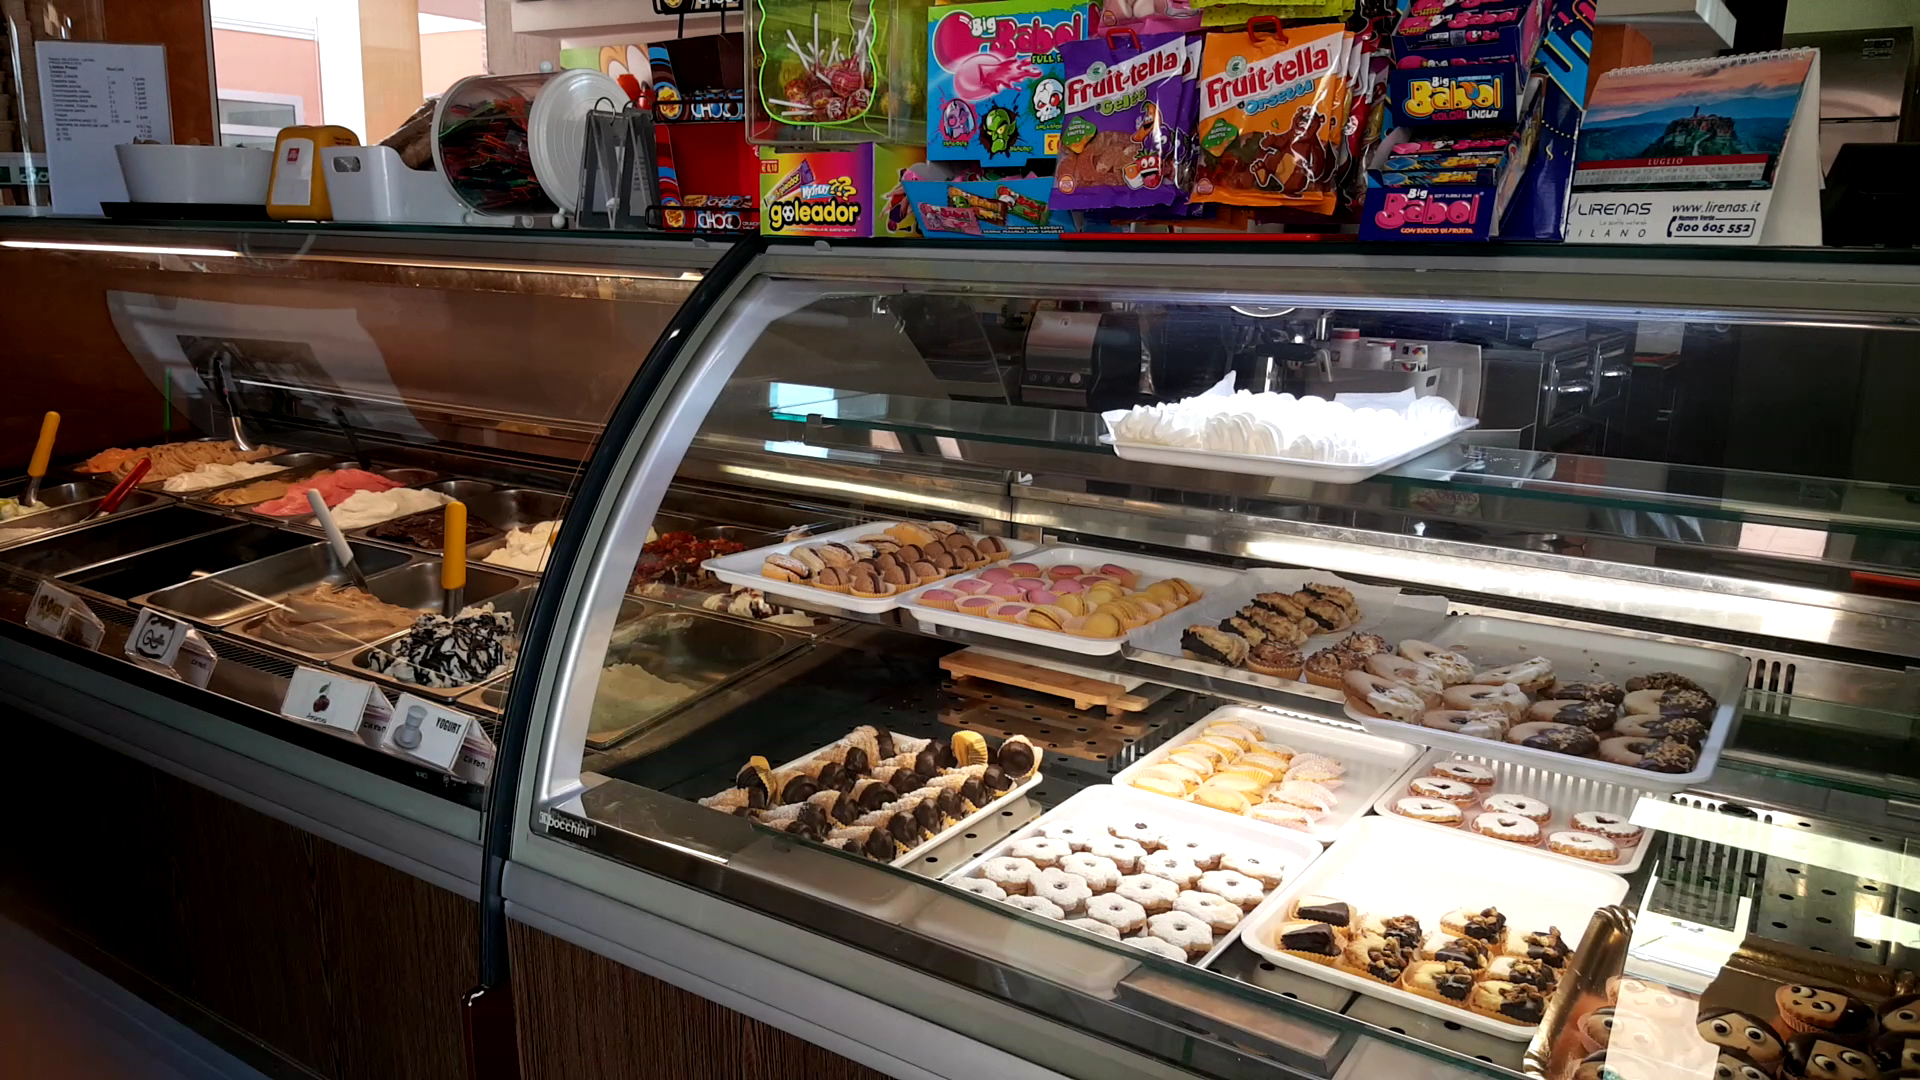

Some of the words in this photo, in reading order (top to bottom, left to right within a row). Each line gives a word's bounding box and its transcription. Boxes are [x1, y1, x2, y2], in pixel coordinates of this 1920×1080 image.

[972, 17, 997, 37] Big
[1032, 54, 1054, 64] FULL
[1067, 50, 1178, 106] Fruit-tella
[1206, 46, 1329, 109] Fruit-tella
[1432, 77, 1449, 87] Big
[1404, 77, 1501, 118] Babol
[1648, 158, 1684, 166] LUGLIO
[1408, 188, 1428, 199] Big
[770, 200, 859, 228] goleador
[1375, 193, 1480, 229] Babol
[1578, 203, 1652, 216] LIRENAS
[1672, 201, 1761, 213] www.lirenas.it
[1676, 223, 1699, 232] 800
[1702, 223, 1725, 233] 605
[1727, 224, 1751, 233] 552
[436, 717, 462, 735] YOGURT
